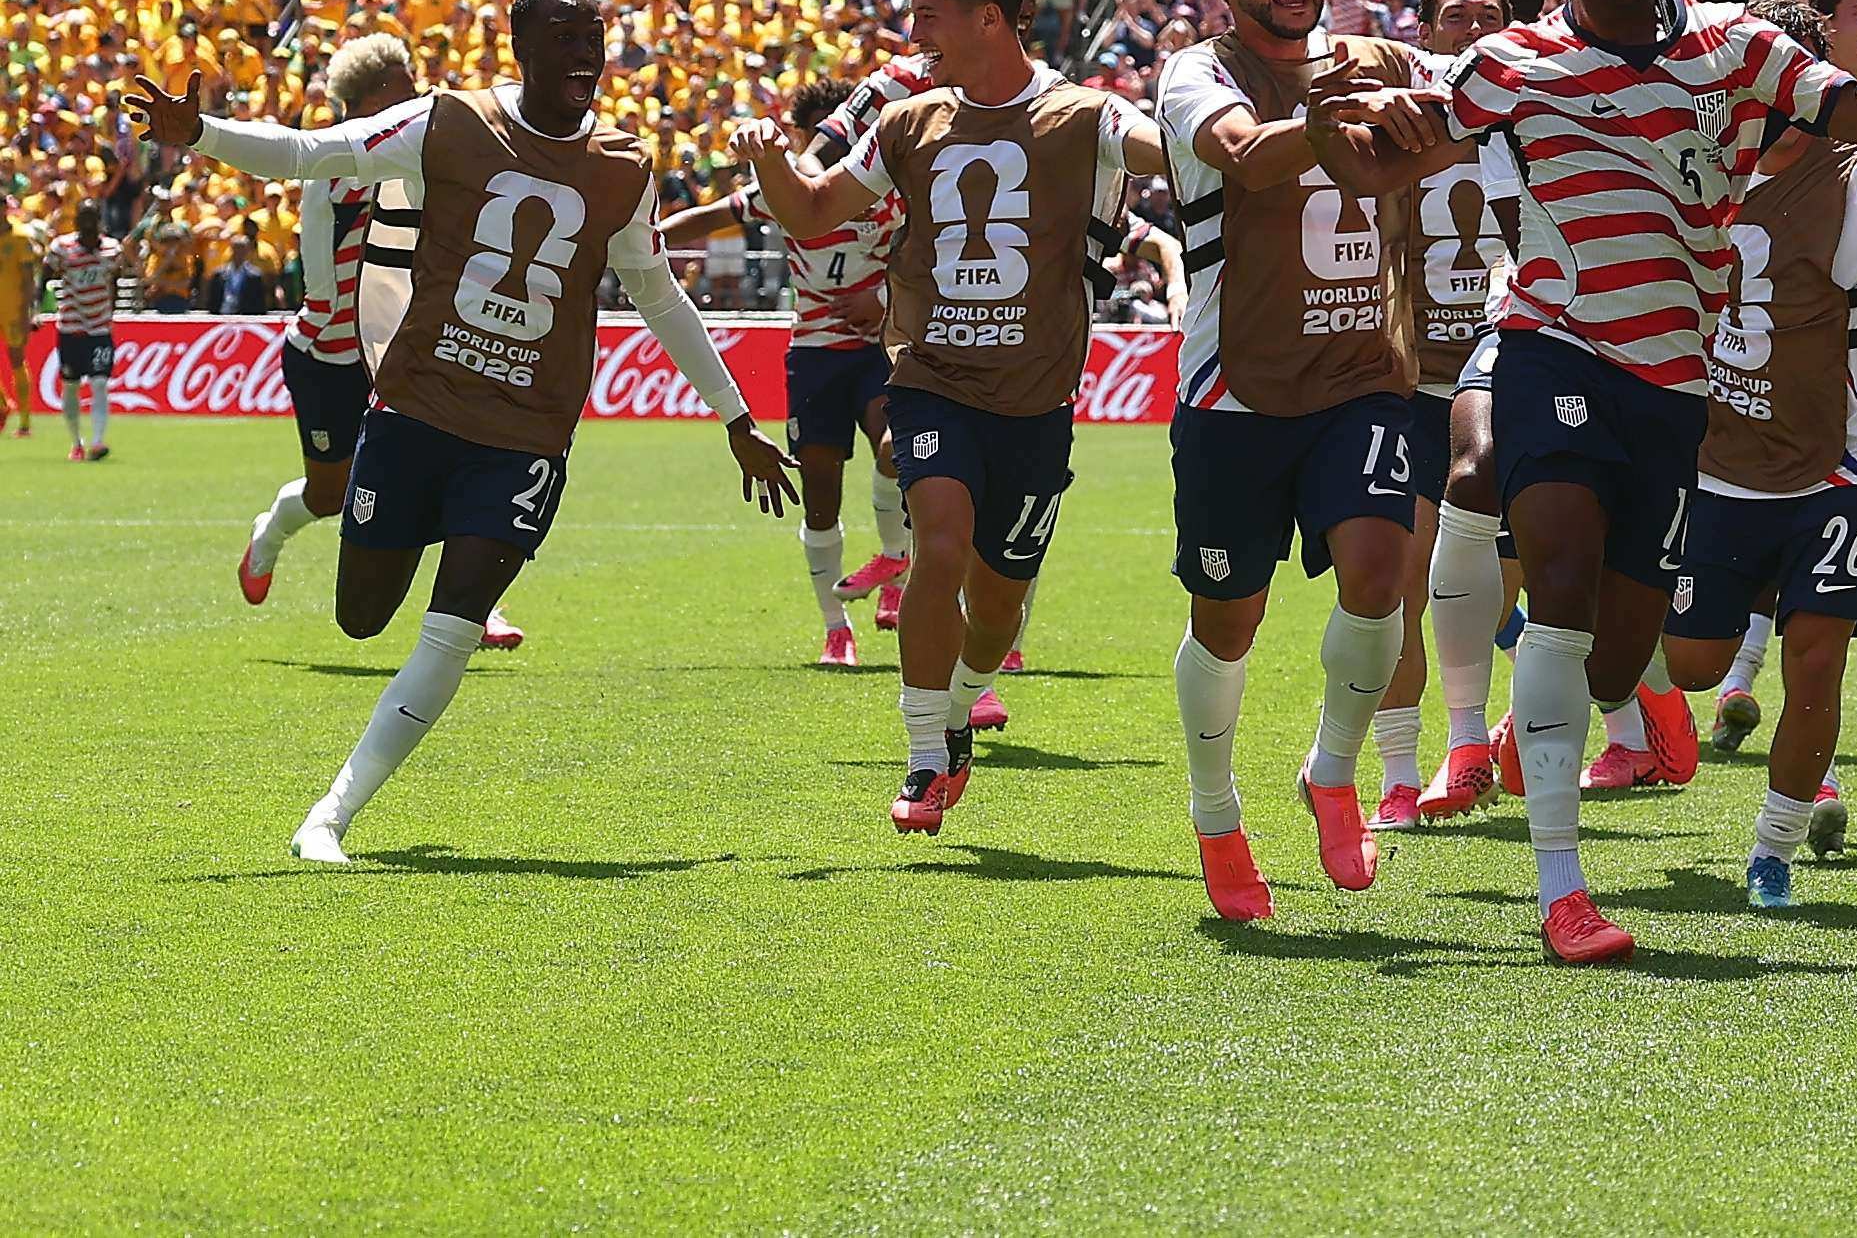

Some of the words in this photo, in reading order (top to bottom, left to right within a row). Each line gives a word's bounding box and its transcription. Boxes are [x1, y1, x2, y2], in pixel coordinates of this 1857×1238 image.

[1696, 93, 1724, 114] USA
[1334, 241, 1375, 262] FIFA
[827, 251, 846, 286] 4
[955, 268, 1001, 285] FIFA
[1302, 286, 1370, 305] WORLD
[481, 299, 527, 327] FIFA
[931, 305, 990, 321] WORLD
[992, 306, 1027, 321] CUP
[1425, 308, 1485, 320] WORLD
[442, 322, 505, 355] WORLD
[506, 346, 541, 364] CUP
[925, 321, 1025, 347] 2026
[1427, 322, 1474, 342] 20
[1721, 331, 1747, 355] FIFA
[434, 338, 534, 387] 2026
[1710, 364, 1741, 387] ORLD
[1741, 377, 1773, 395] CUP
[1556, 397, 1584, 410] USA
[1708, 379, 1773, 421] 026
[914, 431, 937, 445] USA
[1362, 424, 1410, 483] 15
[357, 488, 374, 504] USA
[512, 458, 558, 520] 21
[1005, 492, 1060, 546] 14
[1662, 487, 1690, 556] 1
[1202, 548, 1226, 562] USA
[1679, 578, 1692, 591] SA
